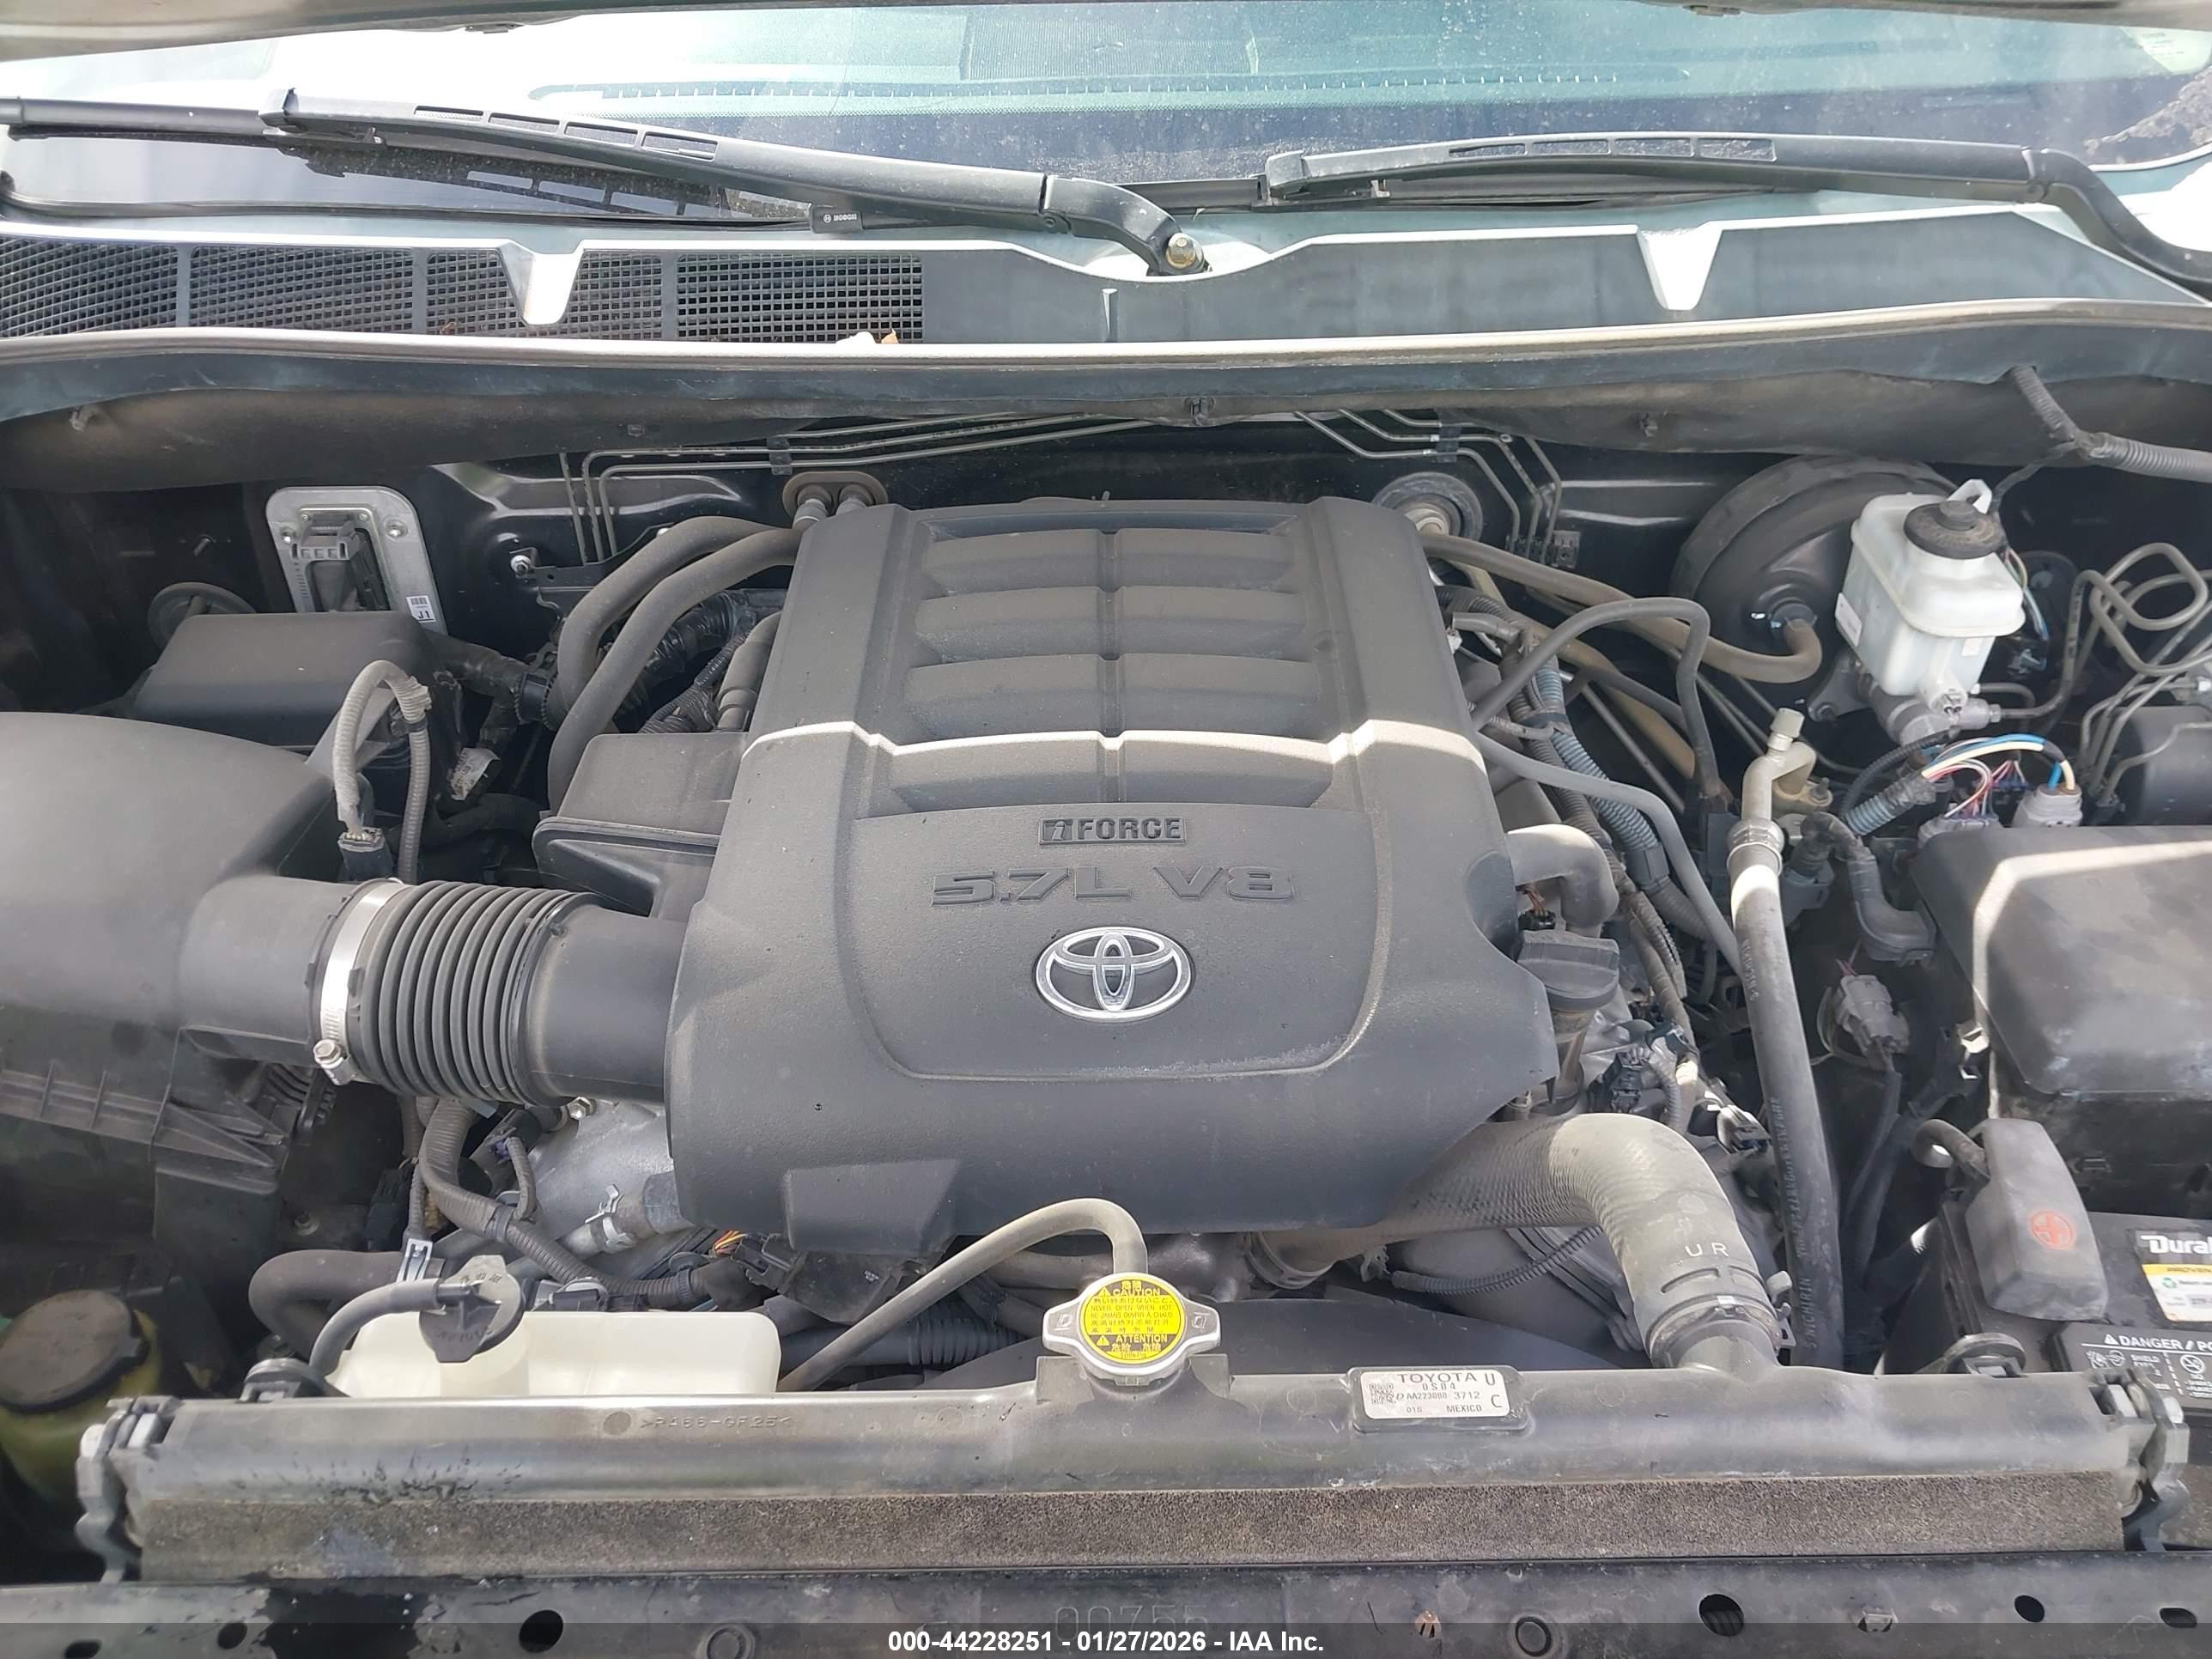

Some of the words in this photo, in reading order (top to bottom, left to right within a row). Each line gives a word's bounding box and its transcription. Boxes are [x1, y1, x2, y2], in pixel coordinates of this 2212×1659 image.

[932, 866, 1131, 905] 5.7L
[1153, 866, 1294, 900] V8
[1115, 1334, 1168, 1343] ATTENTION
[2118, 1334, 2184, 1350] DANGER
[1396, 1372, 1477, 1384] TOYOTA
[1484, 1372, 1497, 1387] U
[1490, 1394, 1503, 1408] C
[1446, 1404, 1482, 1413] MEXICO
